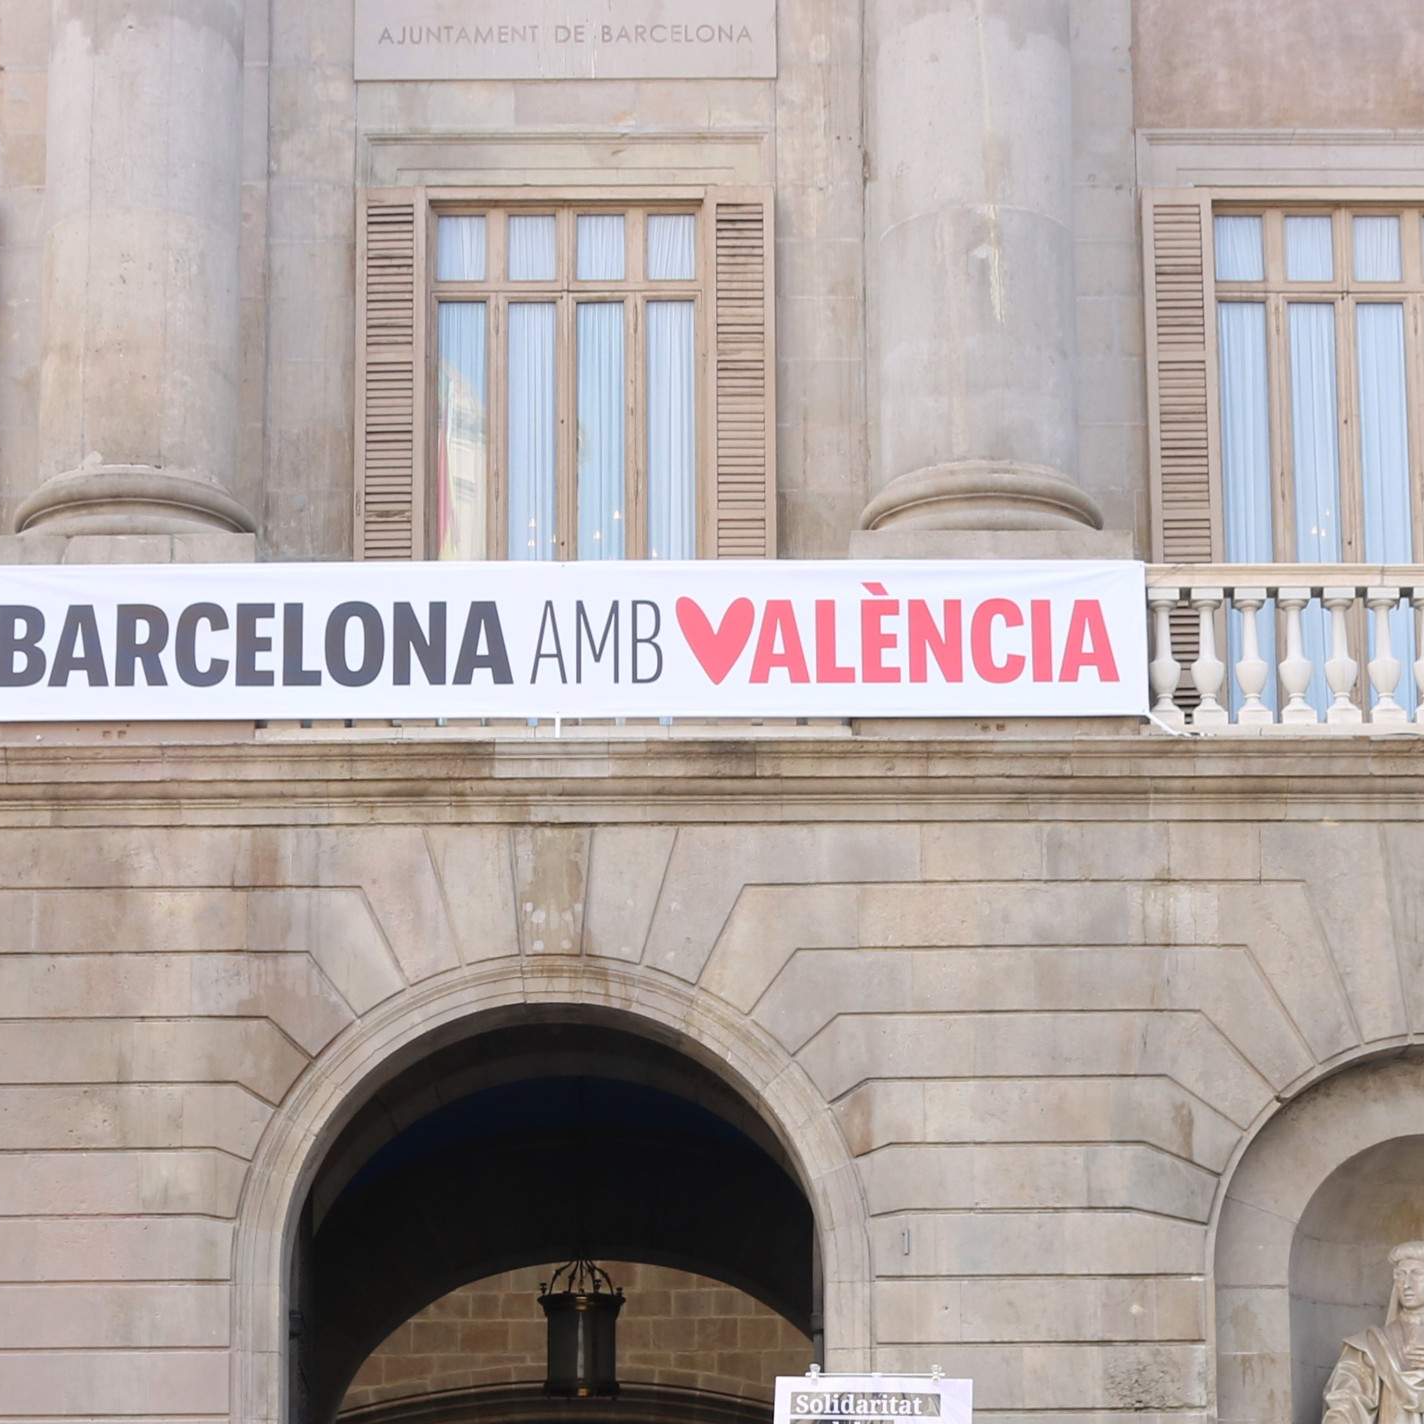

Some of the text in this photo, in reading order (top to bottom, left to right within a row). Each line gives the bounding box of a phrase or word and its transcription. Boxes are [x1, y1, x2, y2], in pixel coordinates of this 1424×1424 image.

[377, 23, 754, 46] AJUNTAMENT DE BARCELONA
[528, 599, 665, 685] AMB
[795, 1393, 923, 1416] Solidaritat
